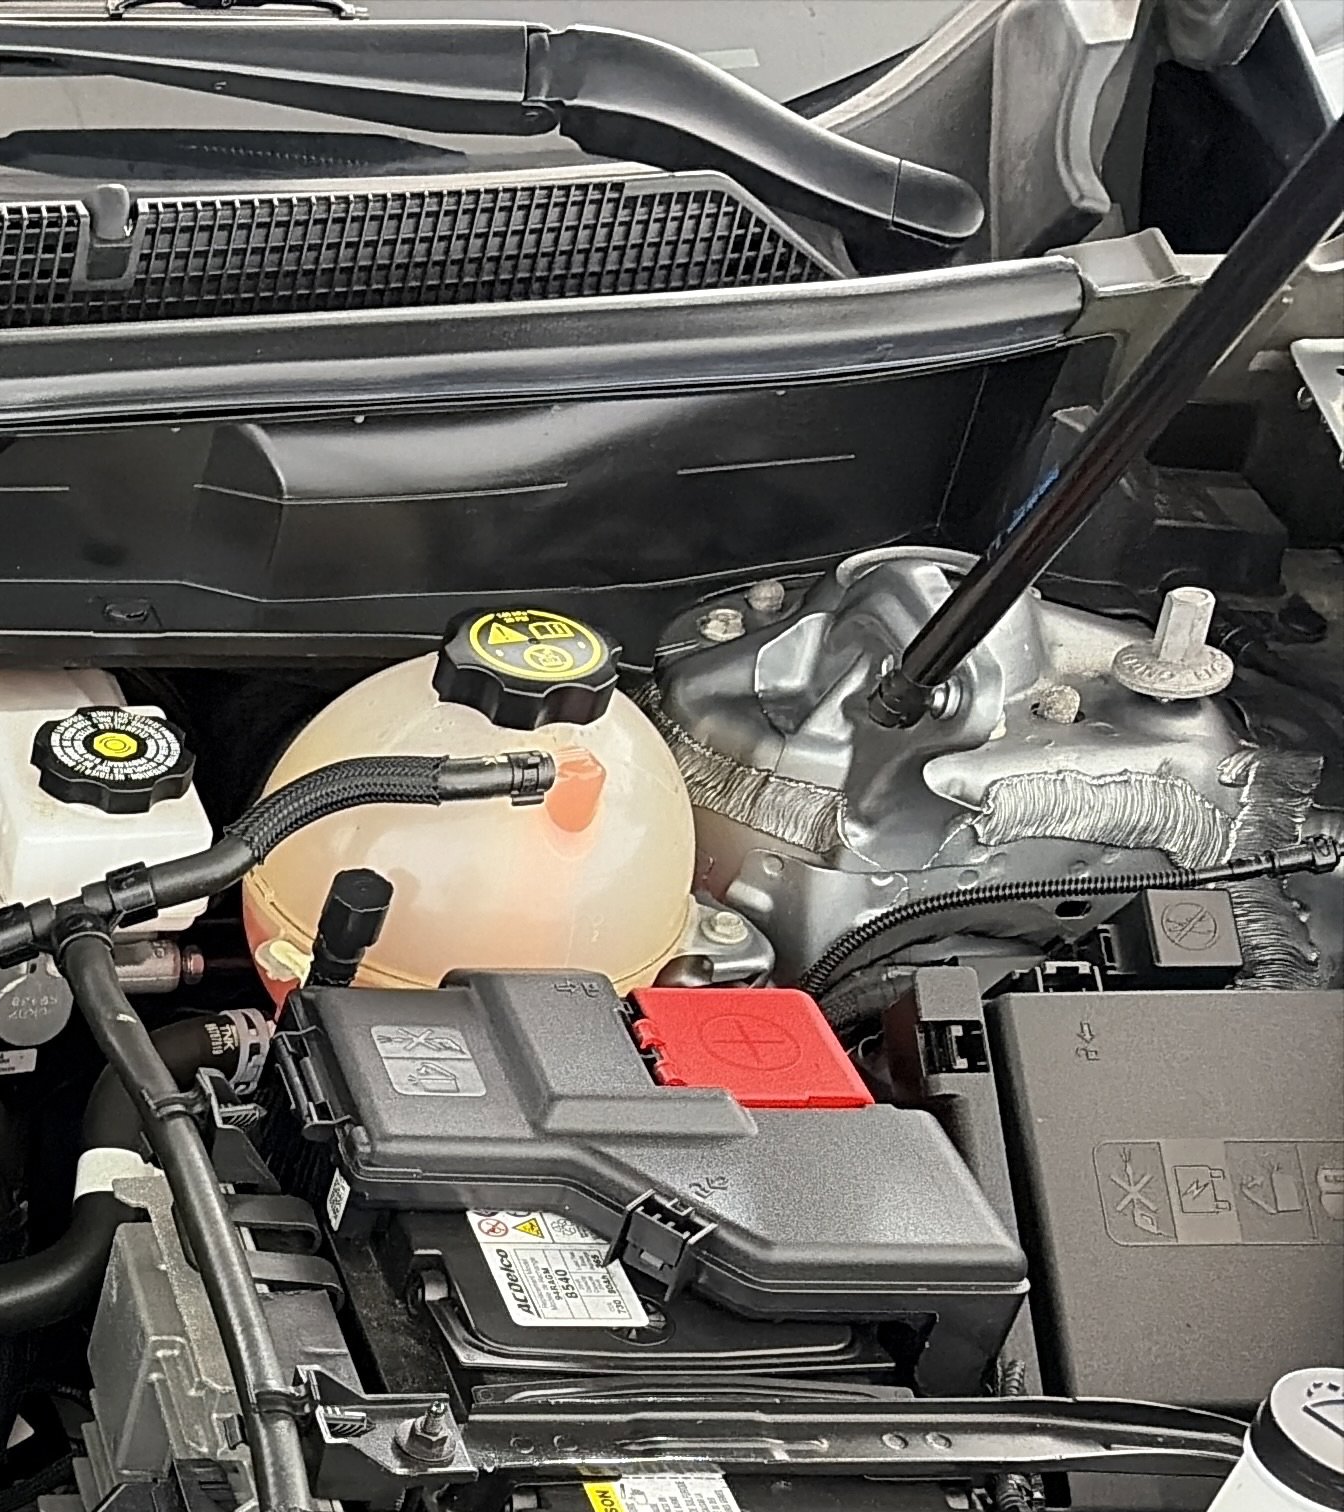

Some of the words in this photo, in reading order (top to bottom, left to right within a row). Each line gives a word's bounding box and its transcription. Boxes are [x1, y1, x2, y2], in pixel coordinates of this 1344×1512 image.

[219, 1023, 235, 1051] TNK
[495, 1248, 535, 1315] ACDelco
[554, 1269, 579, 1299] 8540
[614, 1300, 627, 1314] 730
